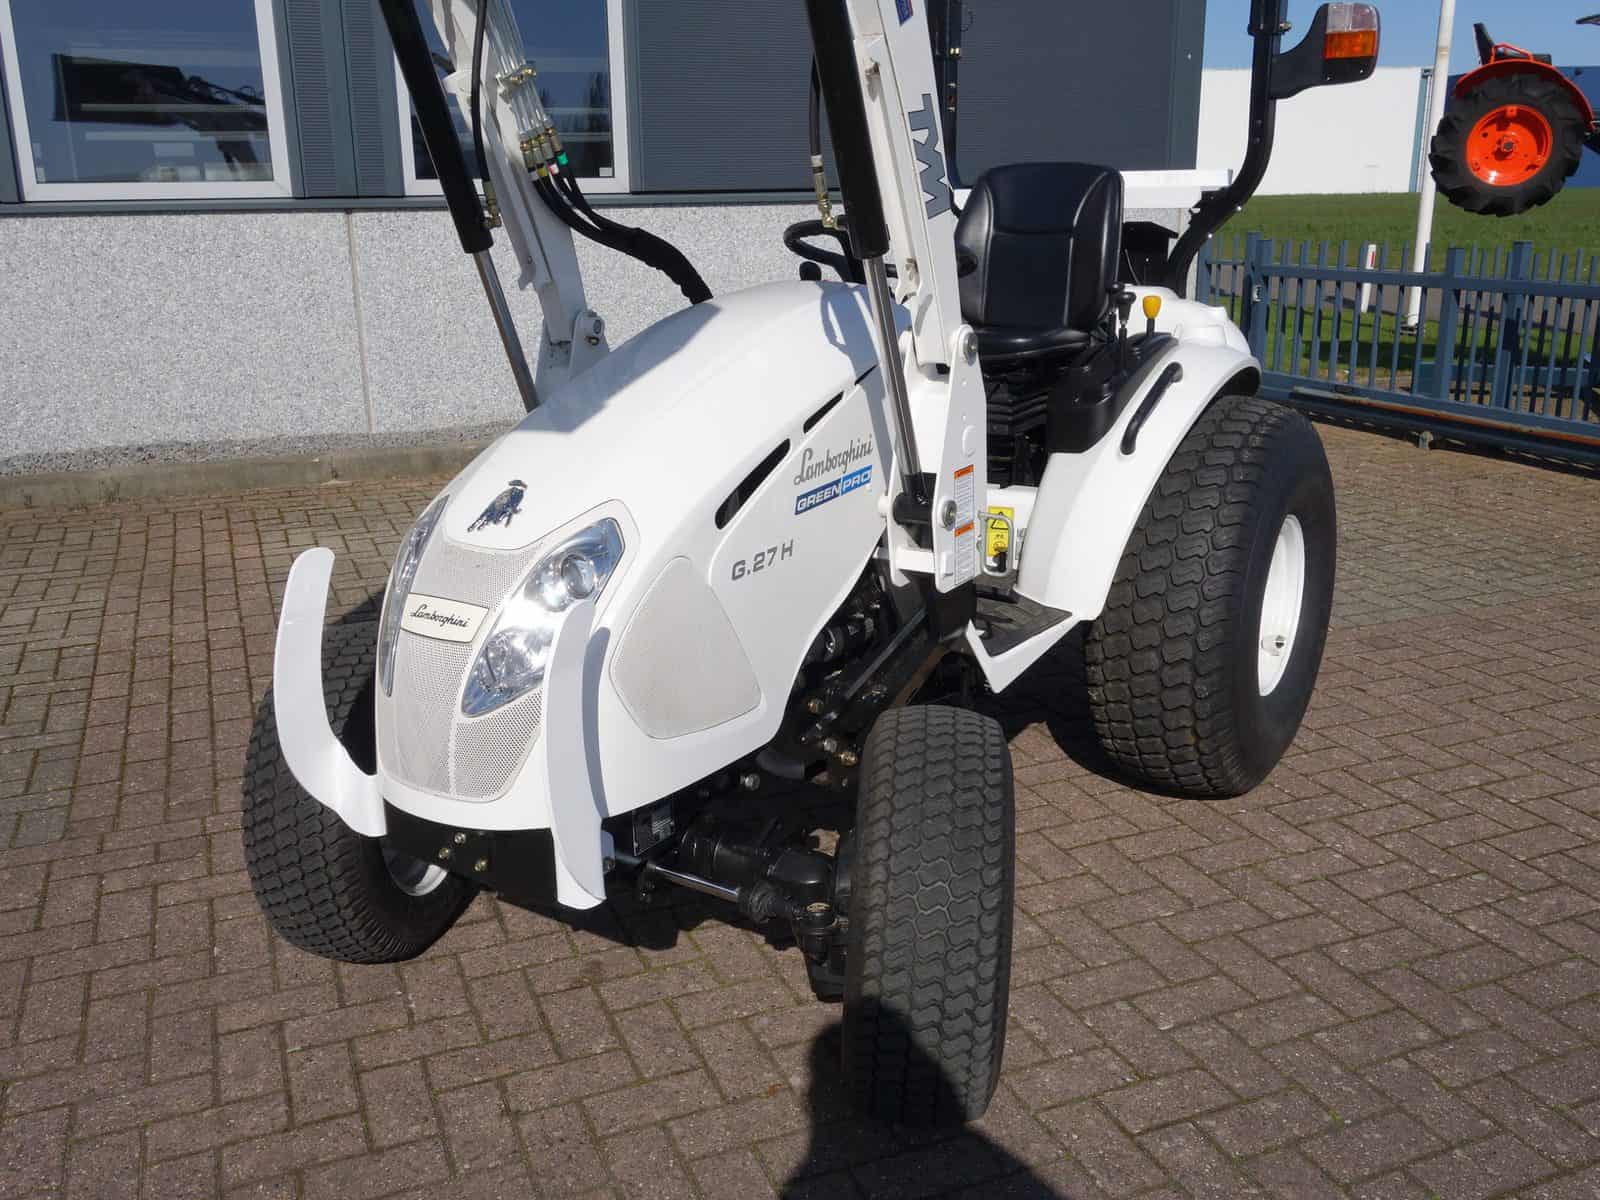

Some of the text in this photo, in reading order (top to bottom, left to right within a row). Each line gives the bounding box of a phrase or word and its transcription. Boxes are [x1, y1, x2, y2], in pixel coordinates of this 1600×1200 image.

[908, 93, 951, 220] TYM
[794, 434, 873, 486] Lamborghini
[797, 470, 871, 511] GREEN PRO
[410, 604, 470, 627] Lamborghini
